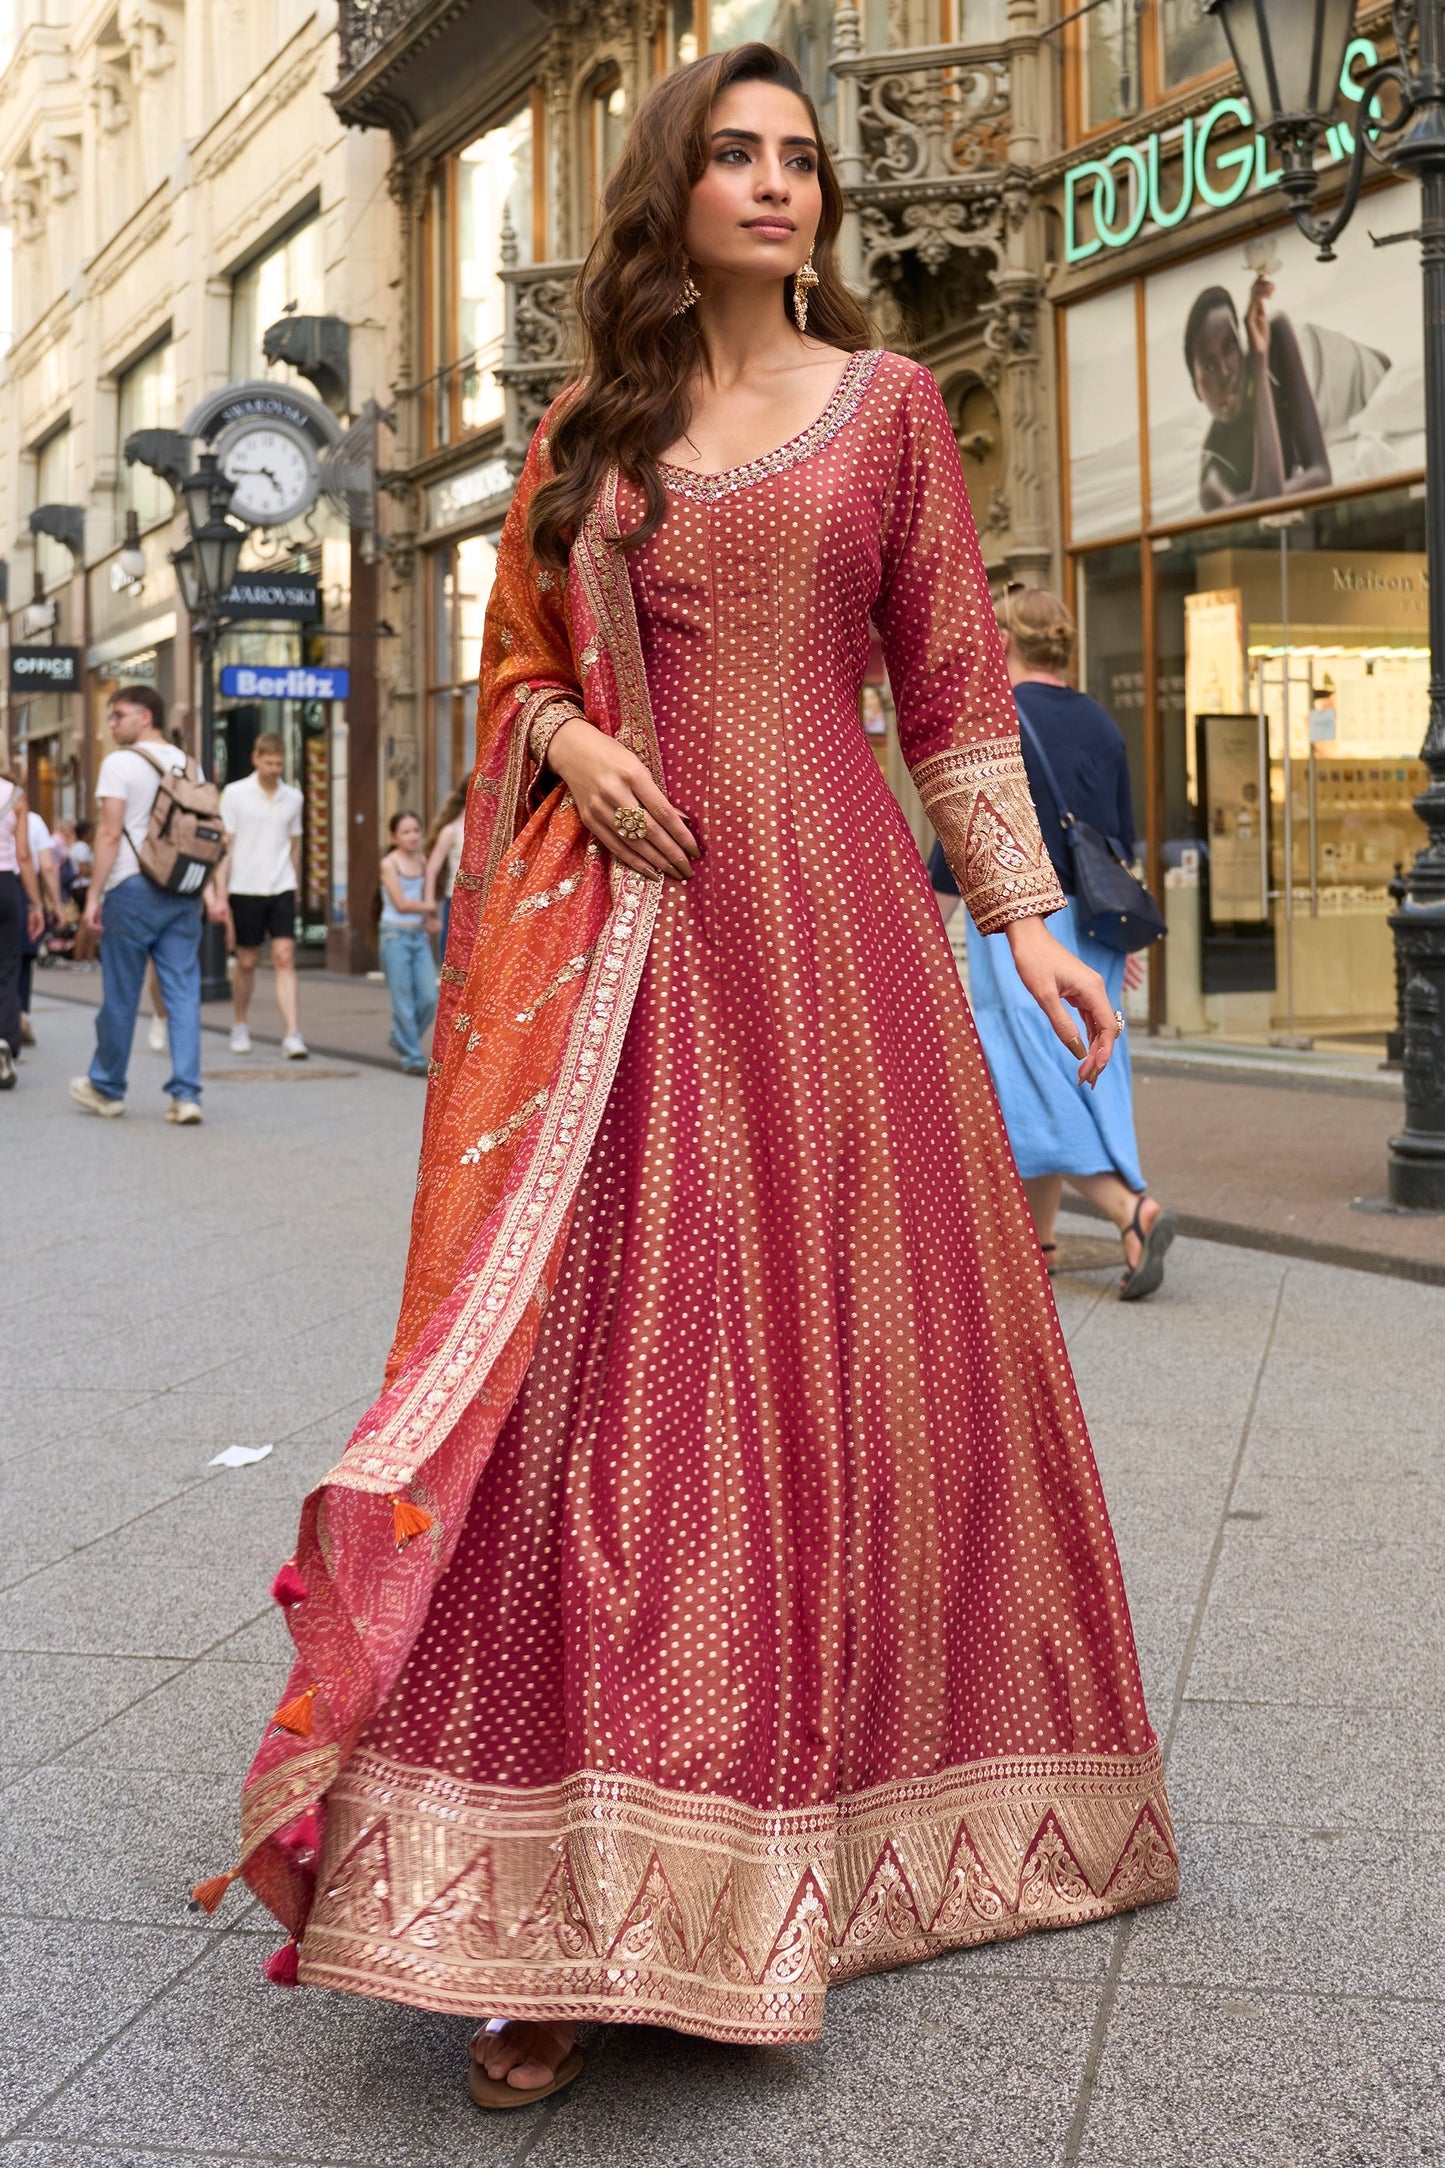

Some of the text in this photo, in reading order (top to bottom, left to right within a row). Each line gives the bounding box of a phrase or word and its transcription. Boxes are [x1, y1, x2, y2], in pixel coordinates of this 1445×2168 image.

[1065, 38, 1382, 263] DOUGLS
[222, 399, 309, 426] SWAROVSKI
[1332, 567, 1412, 592] Maison
[220, 585, 316, 607] WAROVSKI
[13, 657, 73, 675] OFFICE
[236, 669, 334, 696] Berlitz
